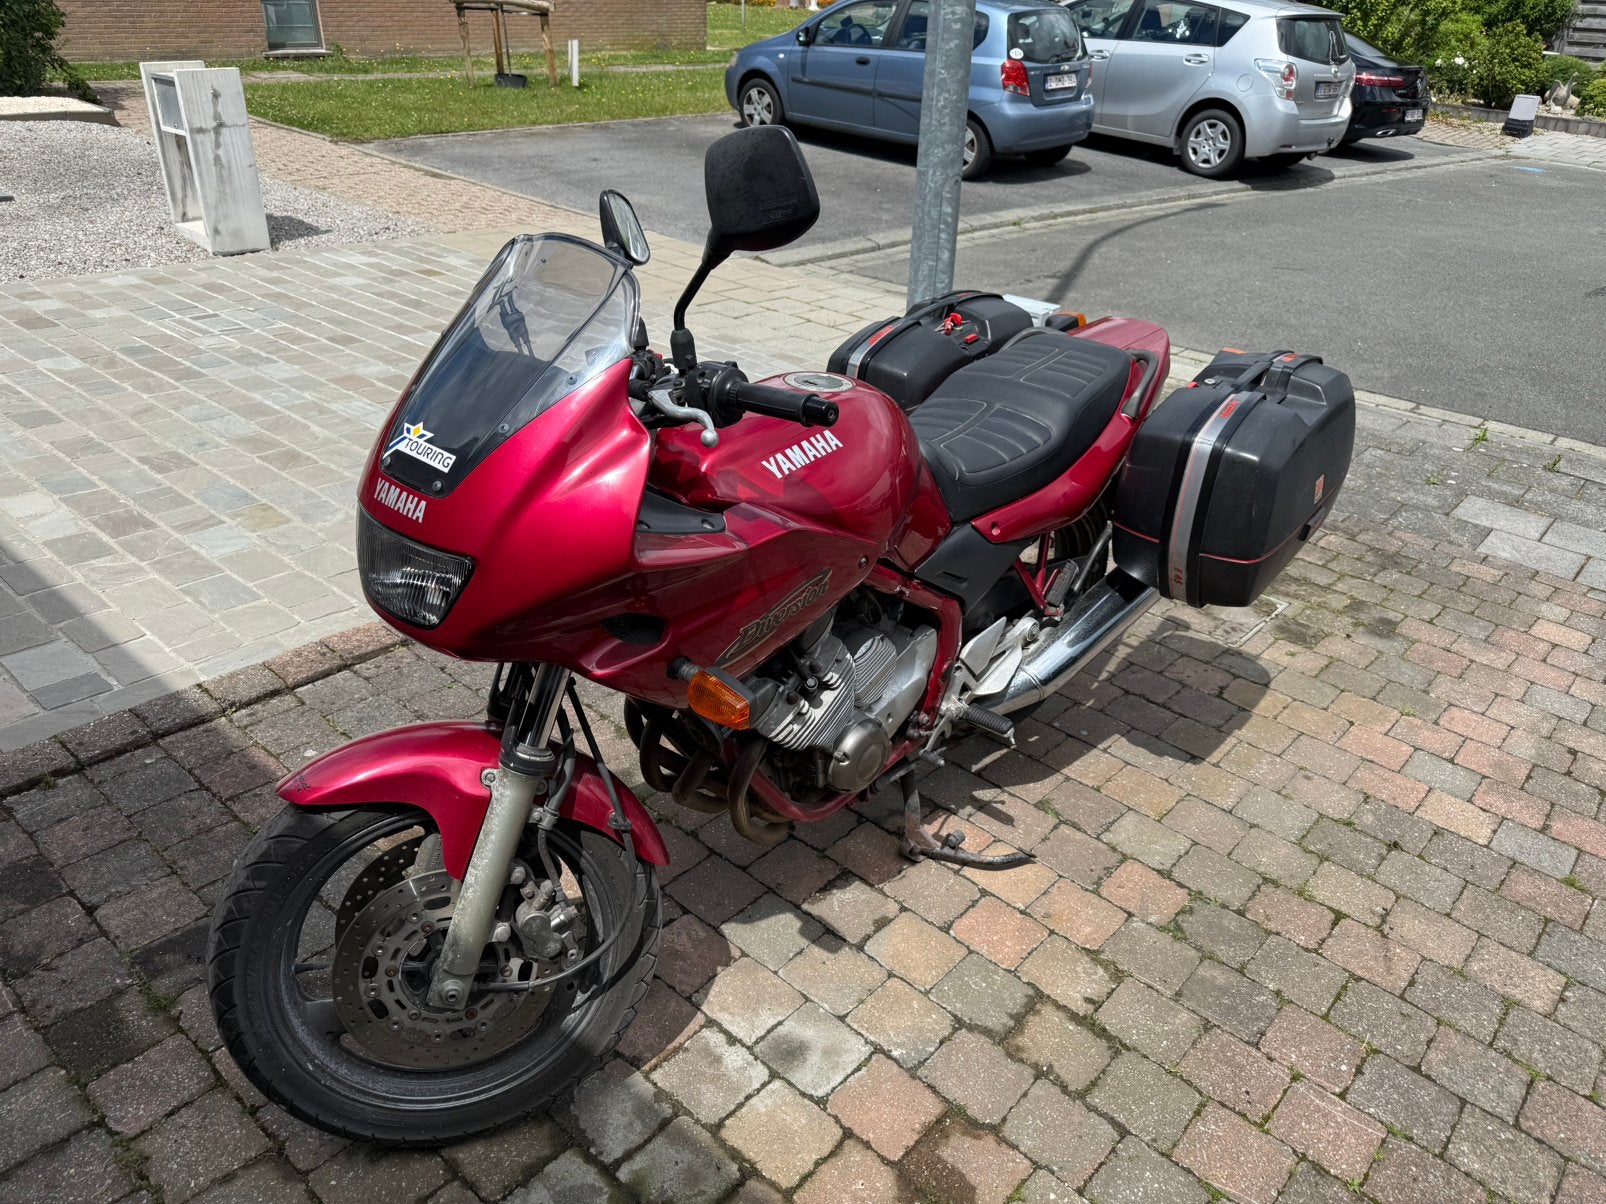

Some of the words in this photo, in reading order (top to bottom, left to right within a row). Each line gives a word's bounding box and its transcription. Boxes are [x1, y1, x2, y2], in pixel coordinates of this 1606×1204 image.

[404, 438, 452, 469] TOURING
[760, 429, 844, 480] YAMAHA
[373, 477, 427, 524] YAMAHA
